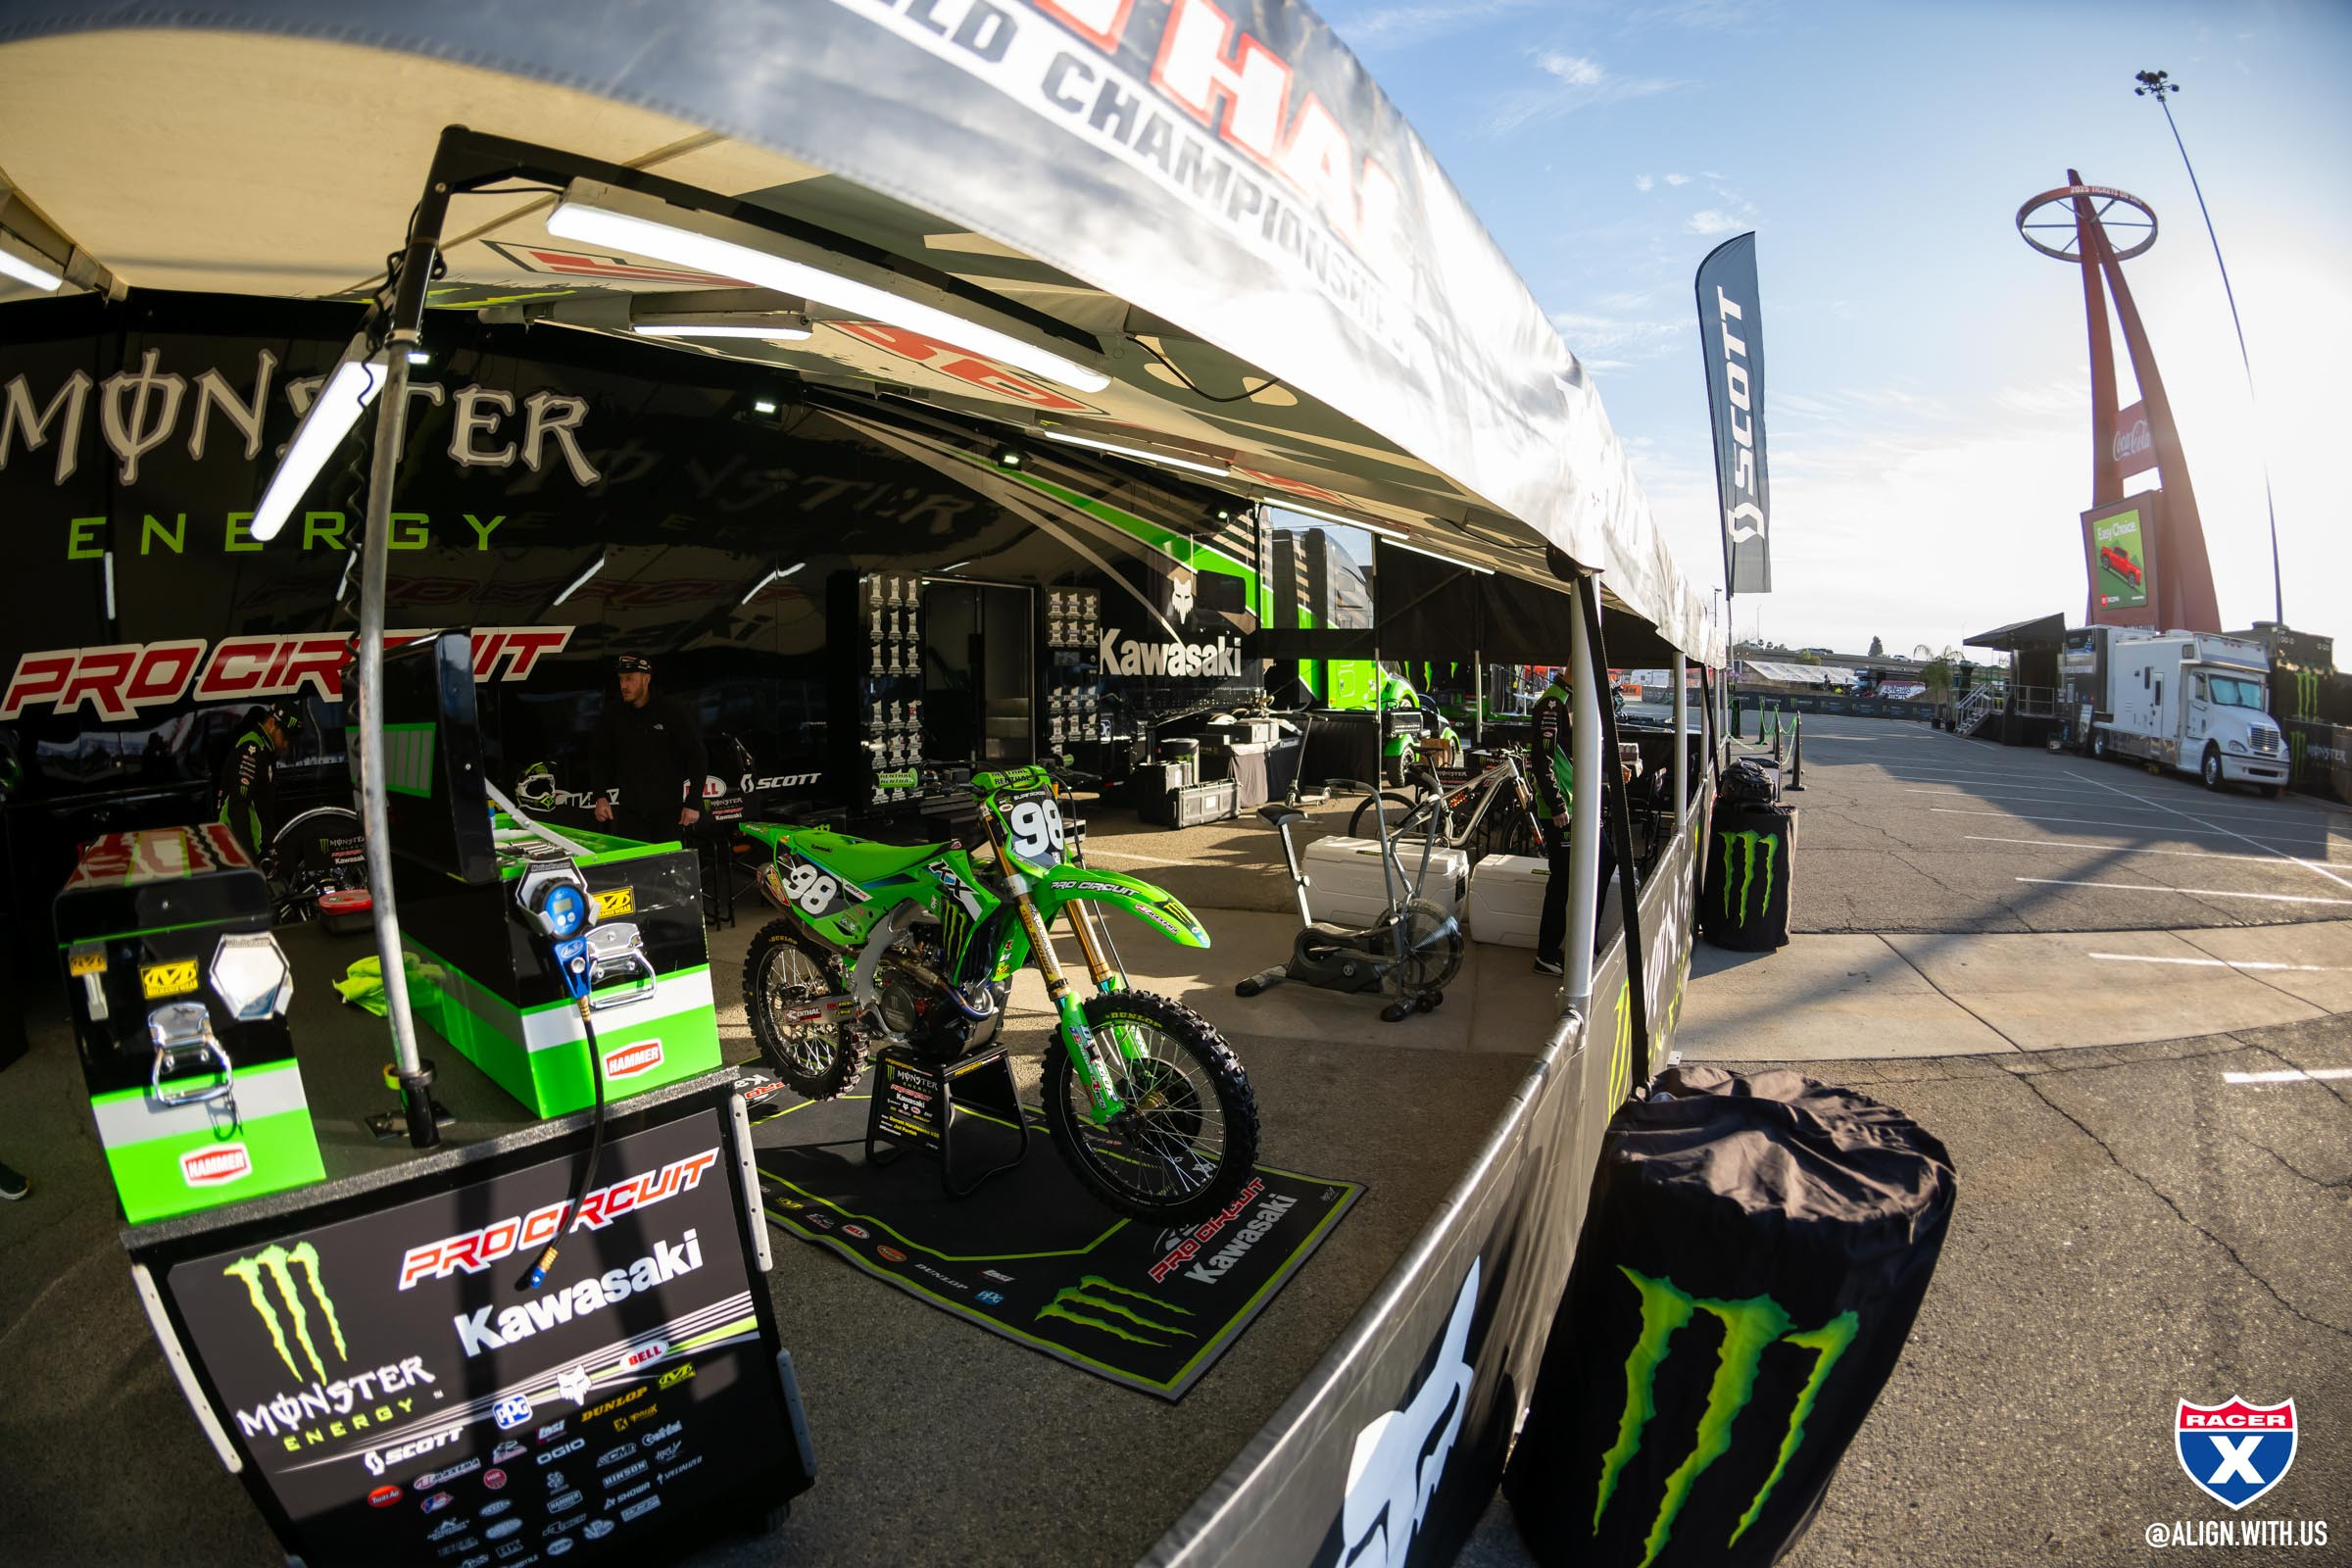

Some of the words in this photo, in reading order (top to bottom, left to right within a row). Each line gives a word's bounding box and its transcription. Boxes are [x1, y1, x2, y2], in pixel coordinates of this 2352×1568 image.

[1716, 285, 1755, 492] SCOTT
[0, 348, 601, 486] MONER
[67, 511, 507, 561] ENERGY
[1099, 626, 1242, 678] Kawasaki
[0, 639, 207, 721] PRO
[194, 625, 575, 704] CIRIT
[756, 773, 822, 790] SCOTT
[329, 835, 366, 847] MONSTE
[1010, 799, 1064, 858] 98
[335, 855, 366, 865] Kawasak
[782, 864, 837, 915] 98
[1051, 881, 1077, 890] PRO
[1078, 881, 1141, 896] CIRCUIT
[1110, 1011, 1163, 1029] DUNLOP
[608, 1042, 659, 1074] HAMMER
[1079, 1024, 1118, 1102] DLOP
[897, 1069, 938, 1091] MONSTER
[896, 1093, 925, 1108] Kawasaki
[186, 1152, 245, 1179] HAMMER
[846, 1225, 866, 1237] BELL
[1148, 1238, 1200, 1284] PRO
[1195, 1176, 1266, 1243] CIRCUIT
[1184, 1193, 1298, 1285] Kawasaki
[398, 1215, 520, 1291] PRO
[914, 1262, 969, 1291] DUNLOP
[453, 1228, 704, 1358] Kawasaki
[628, 1346, 662, 1367] BELL
[236, 1355, 437, 1438] MONSTER
[497, 1396, 530, 1424] PPG
[581, 1386, 649, 1423] DUNLOP
[283, 1396, 415, 1452] ENERGY
[385, 1426, 465, 1466] SCOTT
[536, 1437, 586, 1465] OGIO
[604, 1461, 648, 1488] HINSON
[388, 1490, 400, 1500] Air
[617, 1482, 651, 1503] SHOWA
